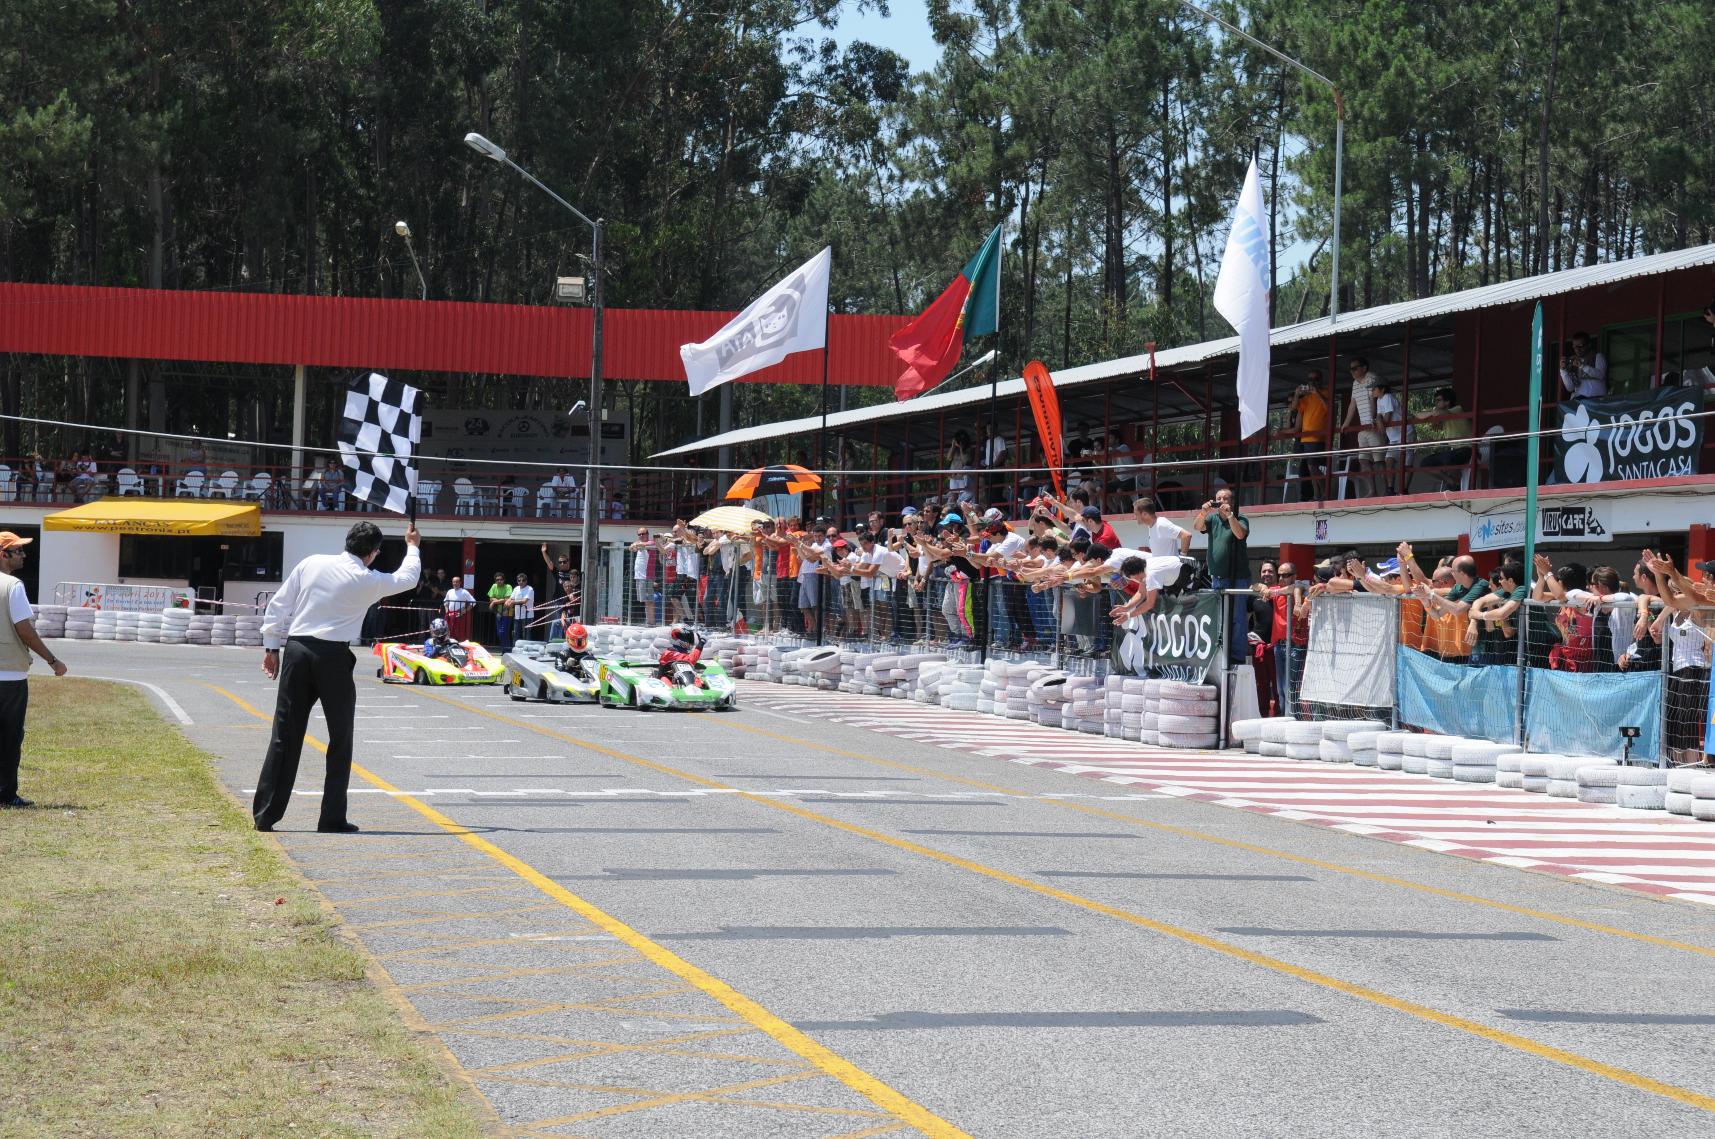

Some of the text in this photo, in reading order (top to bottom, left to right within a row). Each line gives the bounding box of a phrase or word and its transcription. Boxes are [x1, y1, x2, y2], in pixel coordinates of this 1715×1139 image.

[1608, 402, 1696, 475] JOGOS
[1542, 510, 1561, 531] VIRUS
[1149, 613, 1211, 669] JOGOS
